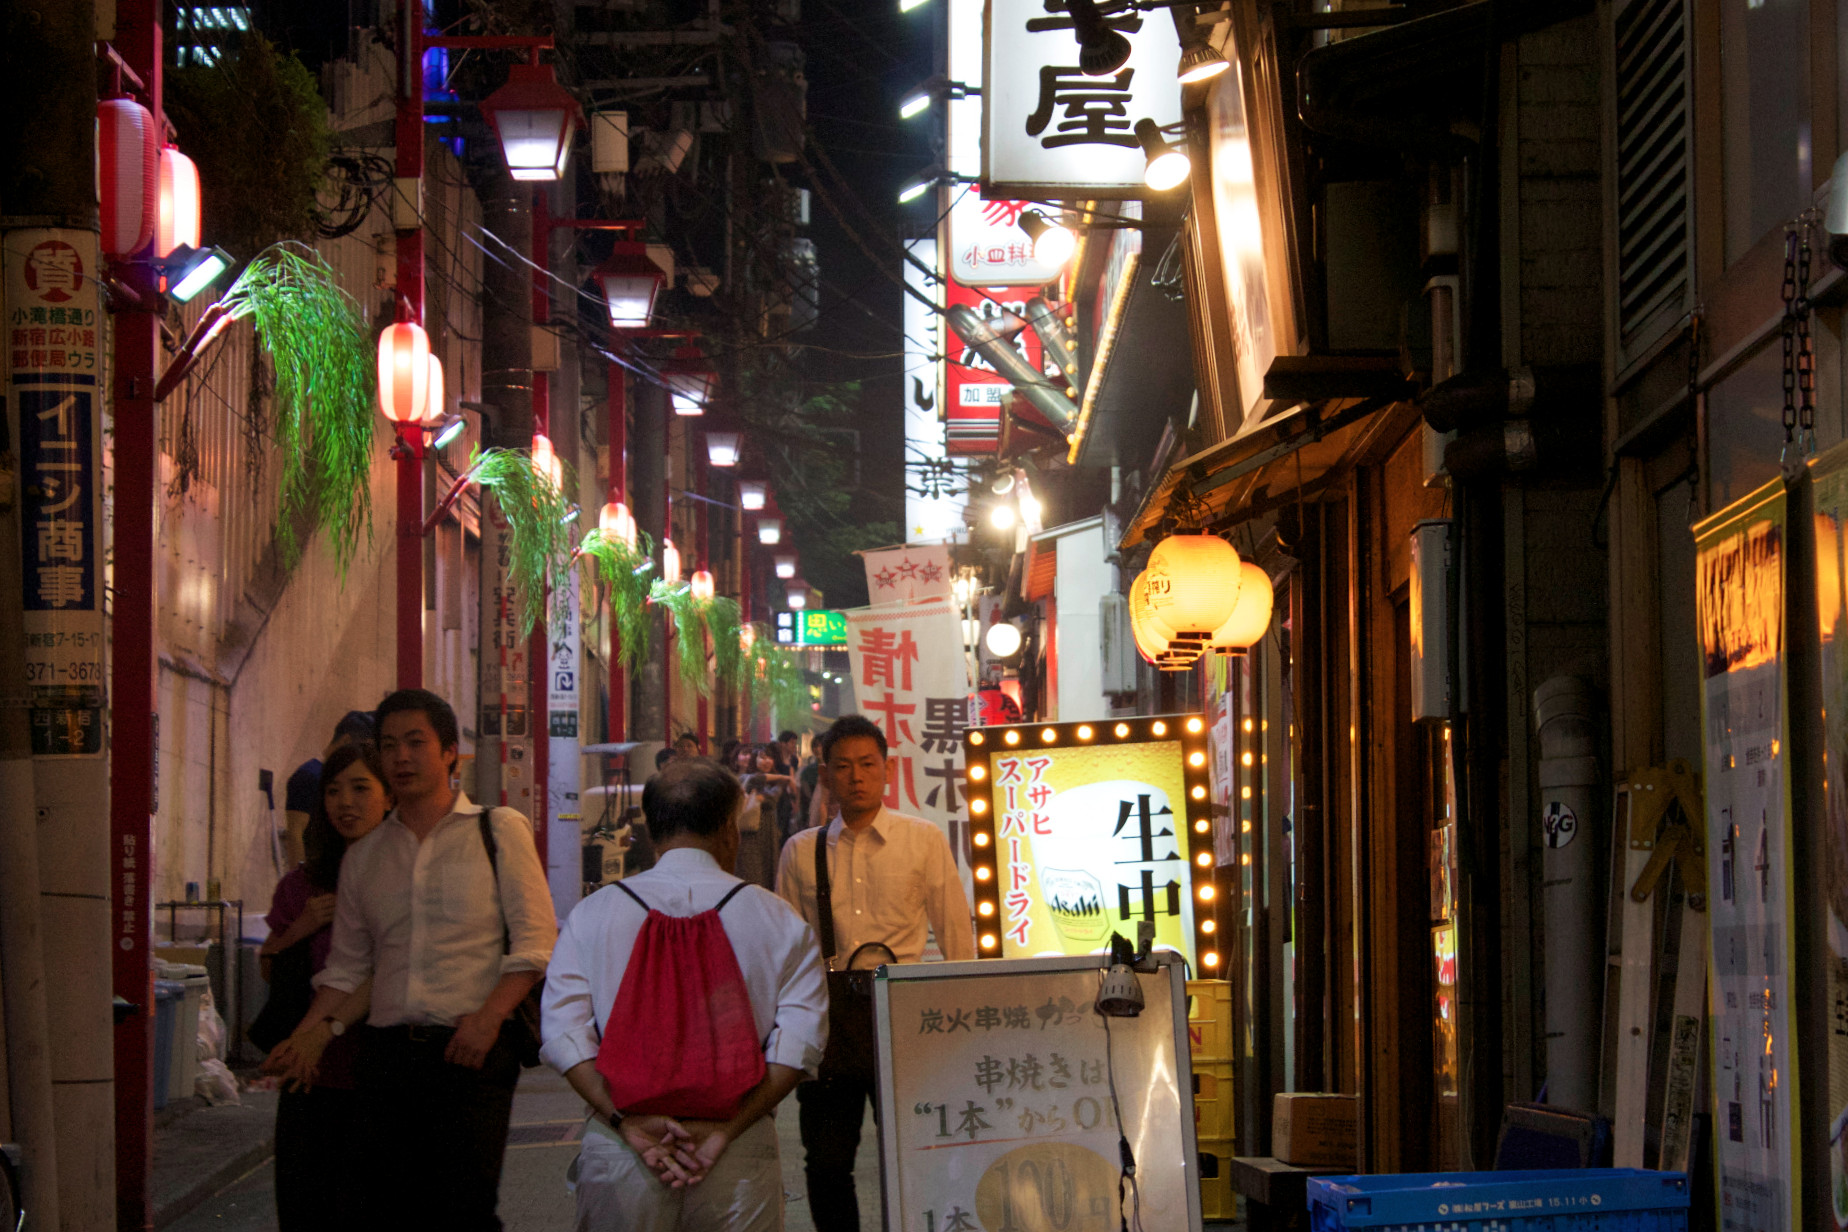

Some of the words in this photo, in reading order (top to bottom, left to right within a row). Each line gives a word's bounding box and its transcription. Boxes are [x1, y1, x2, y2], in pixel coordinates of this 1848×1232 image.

[29, 246, 78, 299] 質
[12, 308, 95, 326] 小滝橋通り
[12, 328, 95, 347] 新宿広小路
[12, 350, 95, 369] 郵便局ウラ
[36, 395, 84, 607] イニシ商事
[806, 613, 847, 637] 思い
[45, 729, 84, 746] 1-2
[1026, 758, 1053, 835] アサヒ
[999, 759, 1032, 945] スーパードライ
[1112, 793, 1182, 938] 生中
[1051, 892, 1100, 917] Asahi
[919, 1005, 1031, 1035] 炭火串焼
[974, 1052, 1109, 1095] 串焼きは
